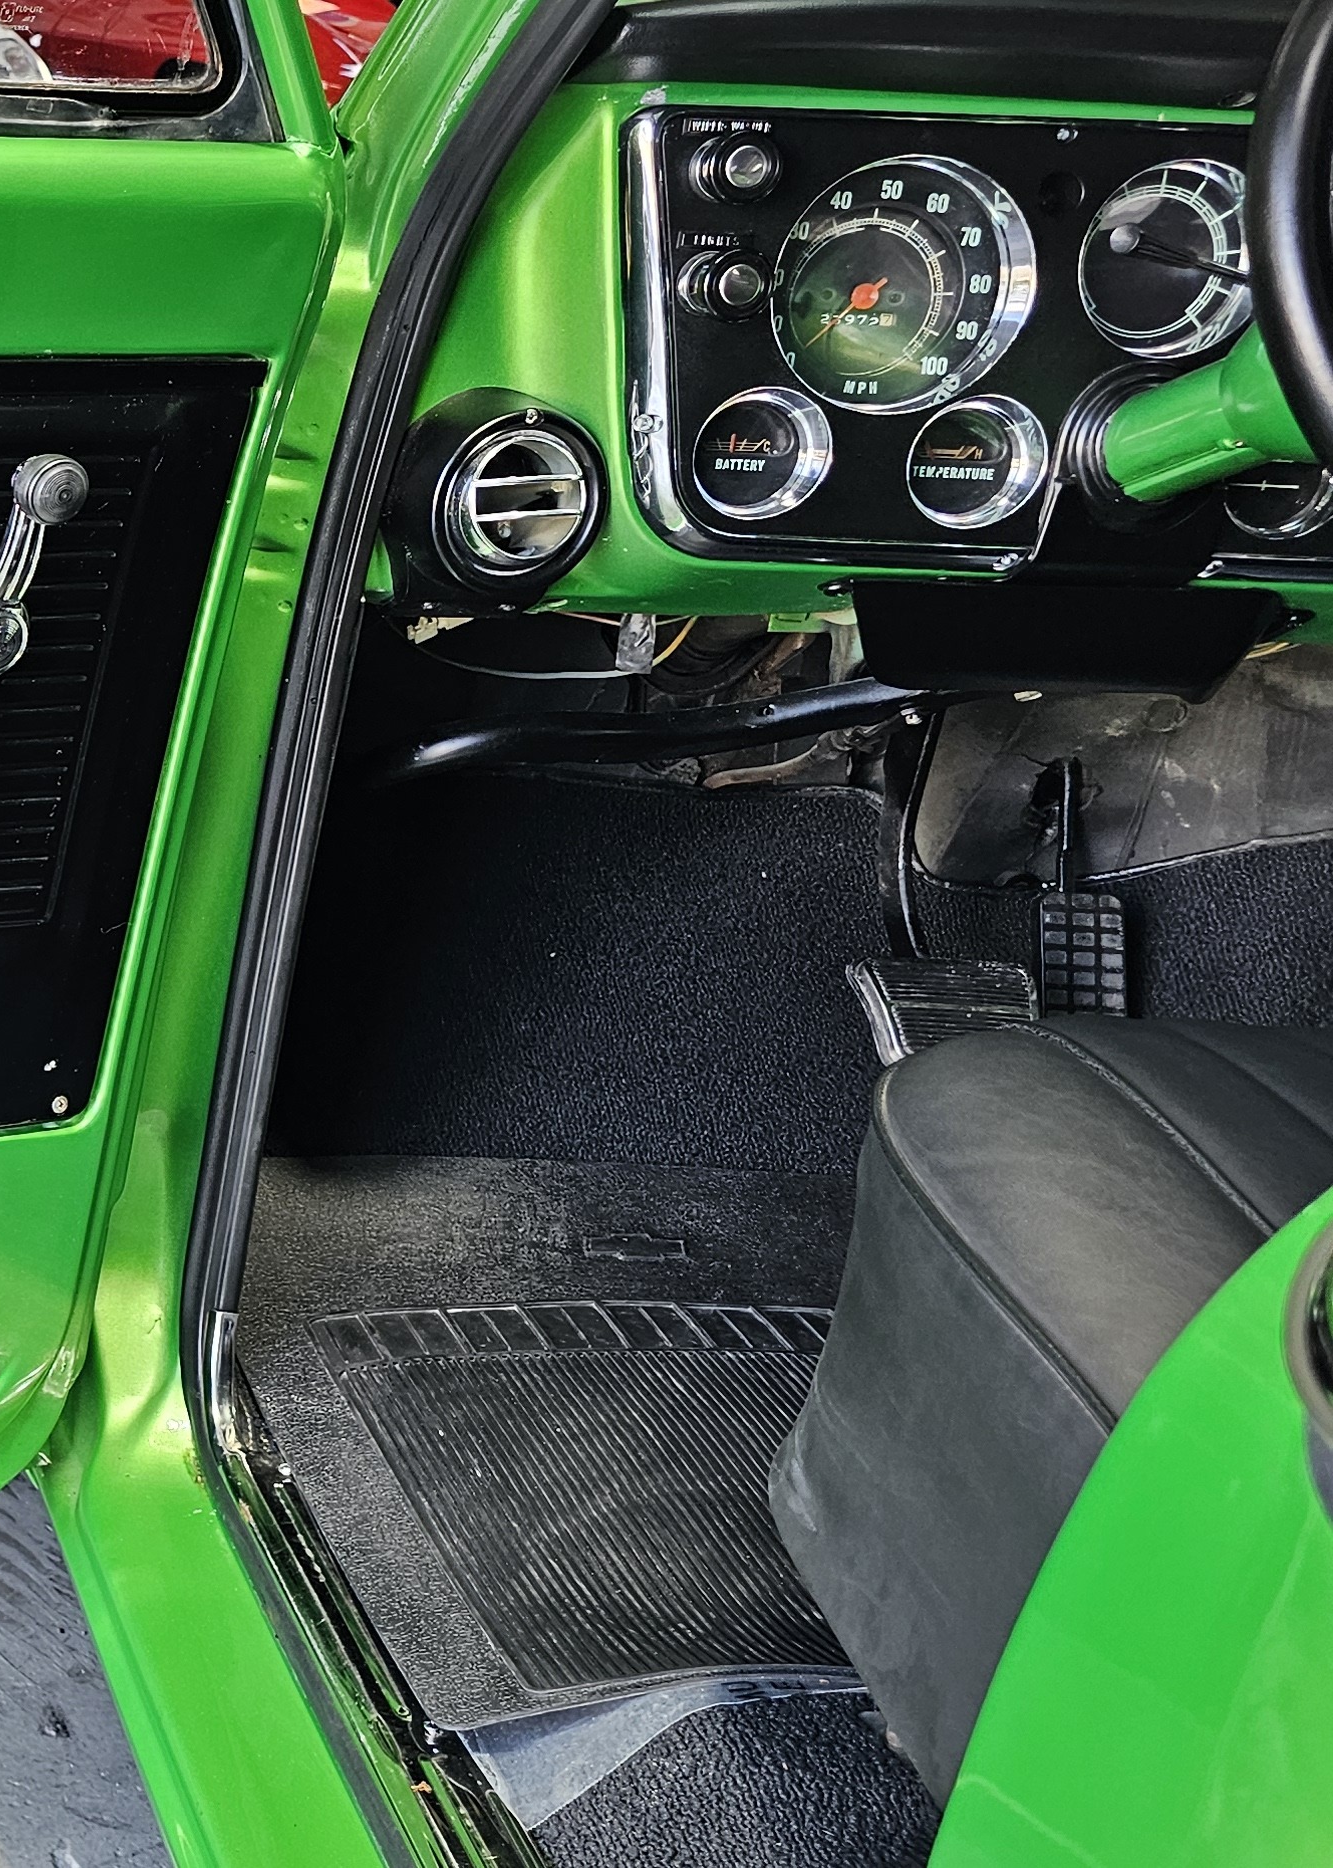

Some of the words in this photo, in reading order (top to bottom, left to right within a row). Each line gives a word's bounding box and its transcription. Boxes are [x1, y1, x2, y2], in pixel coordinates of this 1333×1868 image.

[880, 180, 904, 200] 50
[830, 191, 853, 210] 40
[926, 193, 950, 214] 60
[960, 227, 982, 247] 70
[969, 274, 992, 294] 80
[956, 320, 979, 340] 90
[921, 356, 949, 376] 100
[843, 380, 878, 395] MPH
[715, 457, 766, 472] BATTERY
[912, 465, 995, 481] TEMPERATURE
